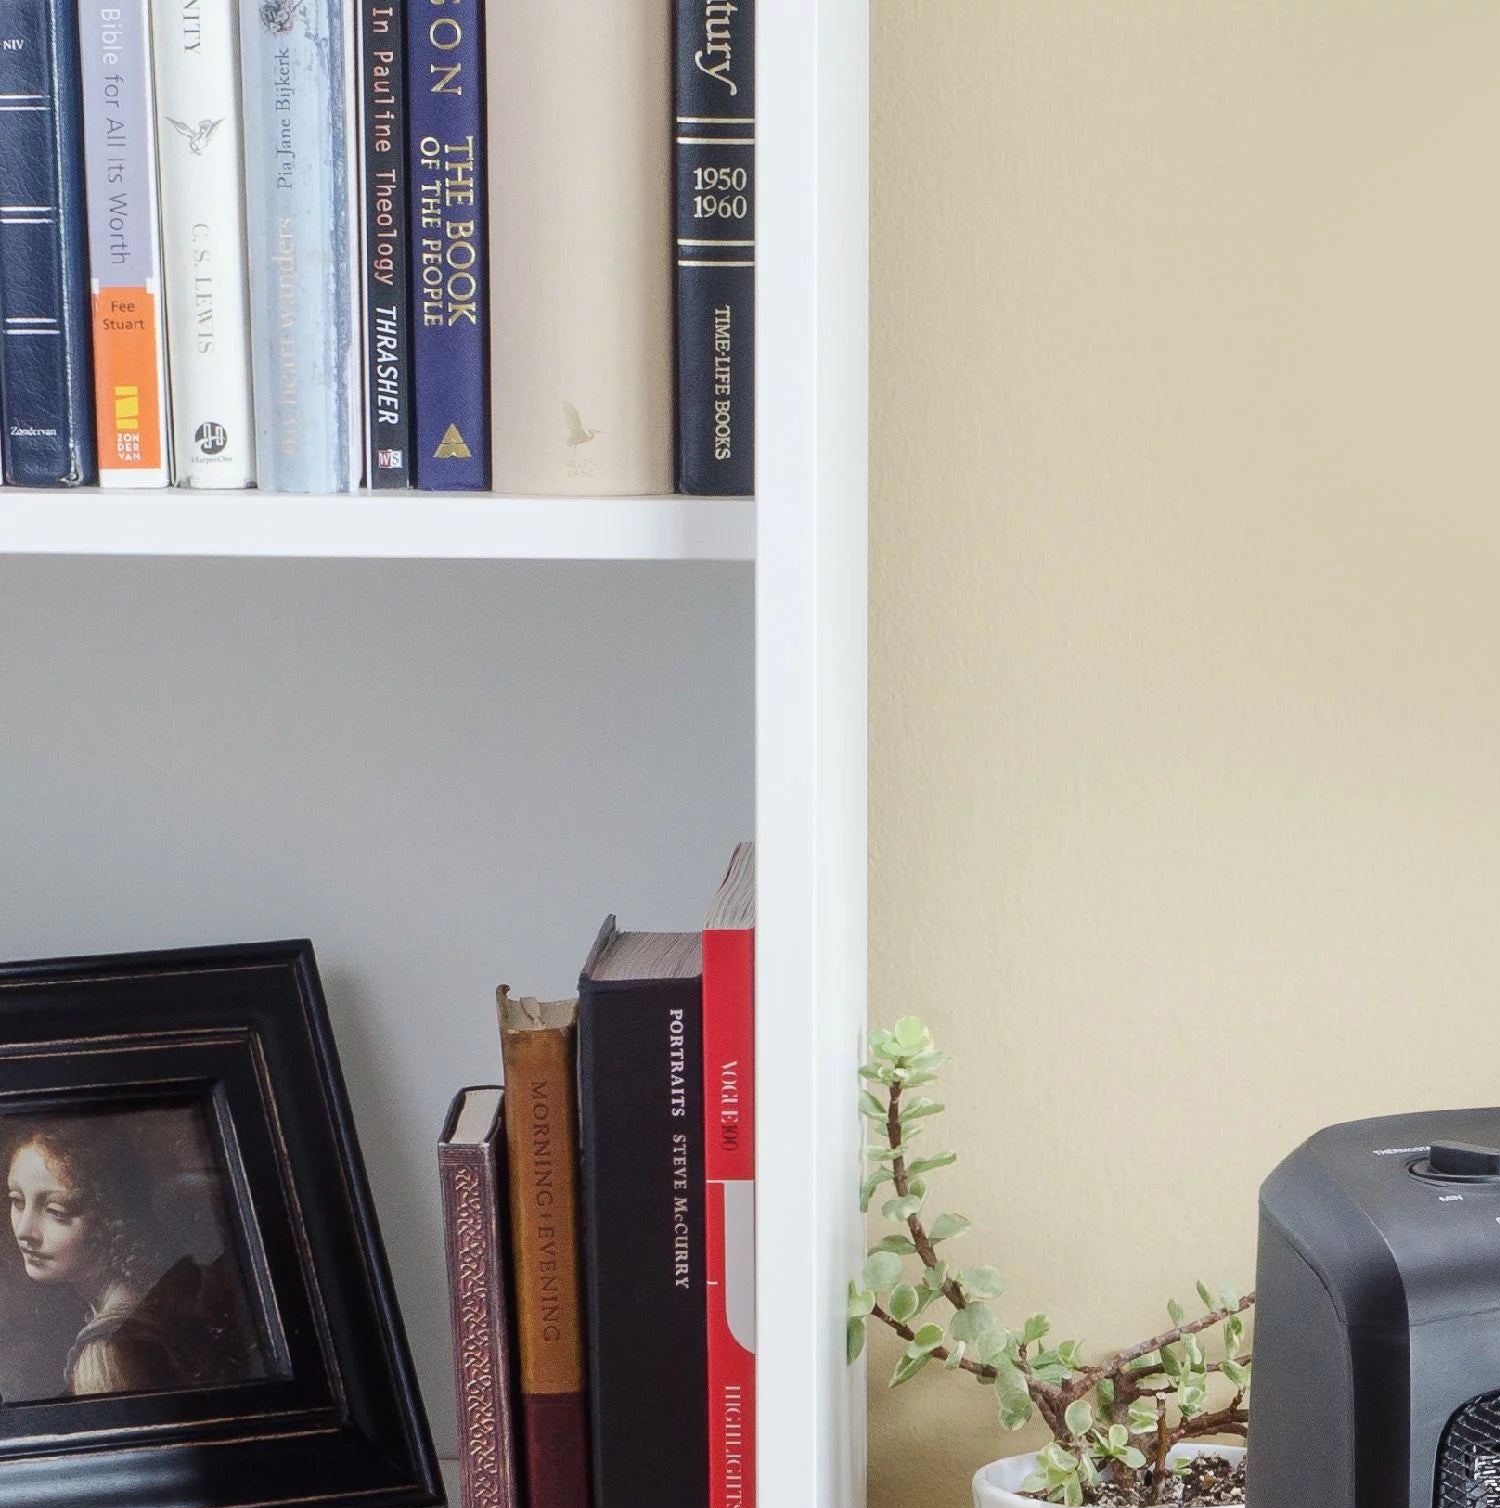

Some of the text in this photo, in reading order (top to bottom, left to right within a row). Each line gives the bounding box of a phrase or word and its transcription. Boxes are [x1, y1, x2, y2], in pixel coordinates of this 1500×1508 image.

[3, 39, 25, 51] NIV
[429, 0, 462, 96] ON
[694, 0, 738, 96] tury
[101, 8, 130, 266] Bible for All Its Worth
[274, 47, 294, 190] Pia Jane Bijkerk
[371, 6, 399, 425] In Pauline Theology THRASHER
[693, 168, 747, 191] 1950
[693, 195, 747, 219] 1960
[420, 136, 444, 328] OF THE PEOPLE
[444, 135, 479, 327] THE BOOK
[110, 300, 136, 313] Fee
[271, 215, 297, 329] wanders
[102, 318, 146, 332] Stuart
[194, 275, 215, 355] LEWIS
[10, 424, 58, 437] Zondervan
[116, 433, 140, 443] ZON
[117, 443, 140, 452] DER
[117, 452, 141, 462] VAN
[714, 399, 732, 461] BOOKS
[531, 1080, 554, 1206] MORNING
[670, 1008, 690, 1290] PORTRAITS STEVE McCURRY
[1372, 1145, 1431, 1156] THERMOSTA
[537, 1226, 561, 1343] EVENING
